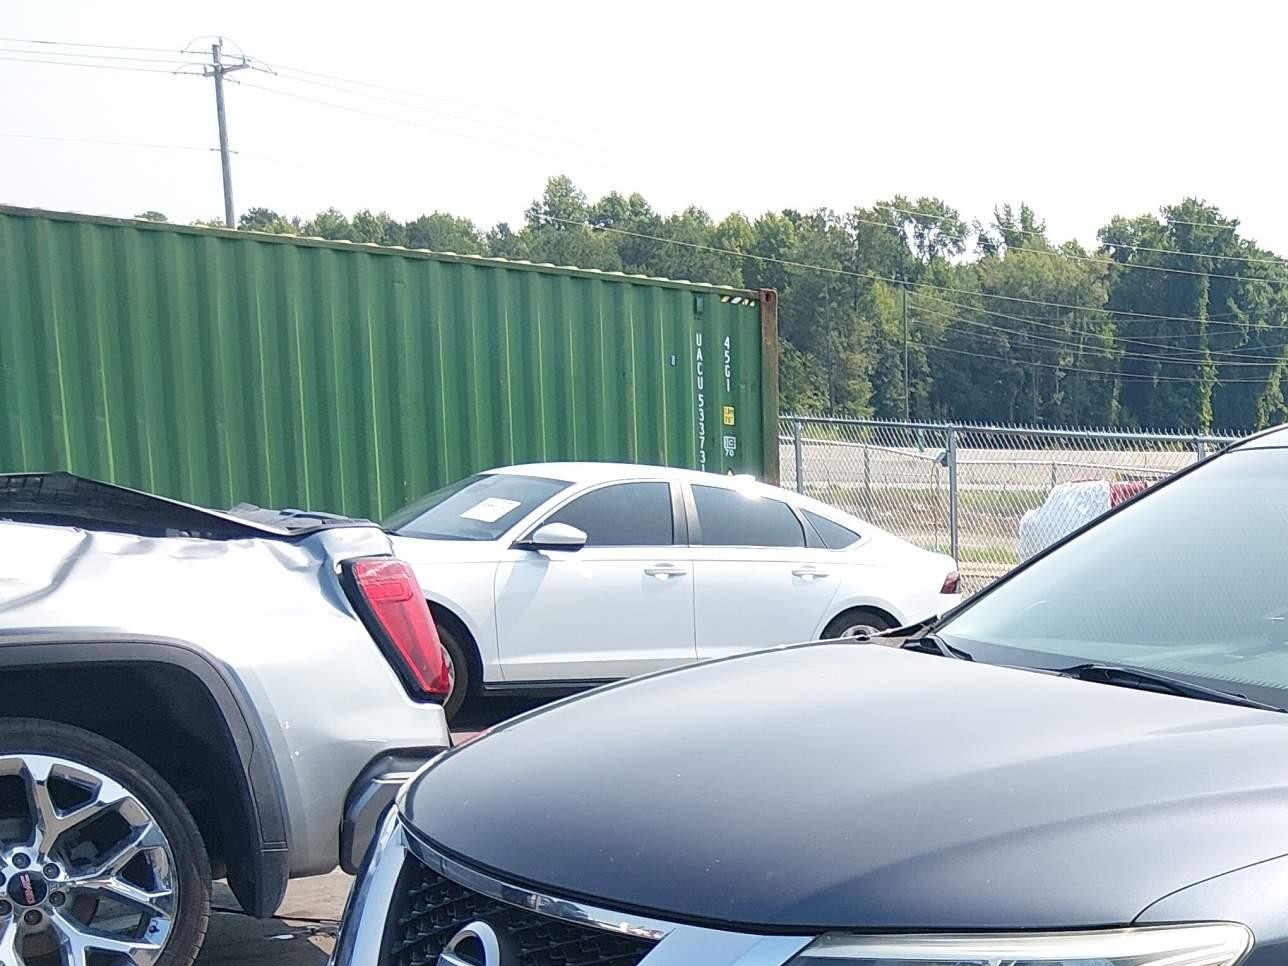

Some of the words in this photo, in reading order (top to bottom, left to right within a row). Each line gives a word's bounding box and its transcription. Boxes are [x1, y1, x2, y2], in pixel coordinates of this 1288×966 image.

[695, 333, 704, 390] UACU
[723, 336, 731, 393] 45G1
[725, 448, 734, 457] 70
[20, 873, 36, 905] GMC
